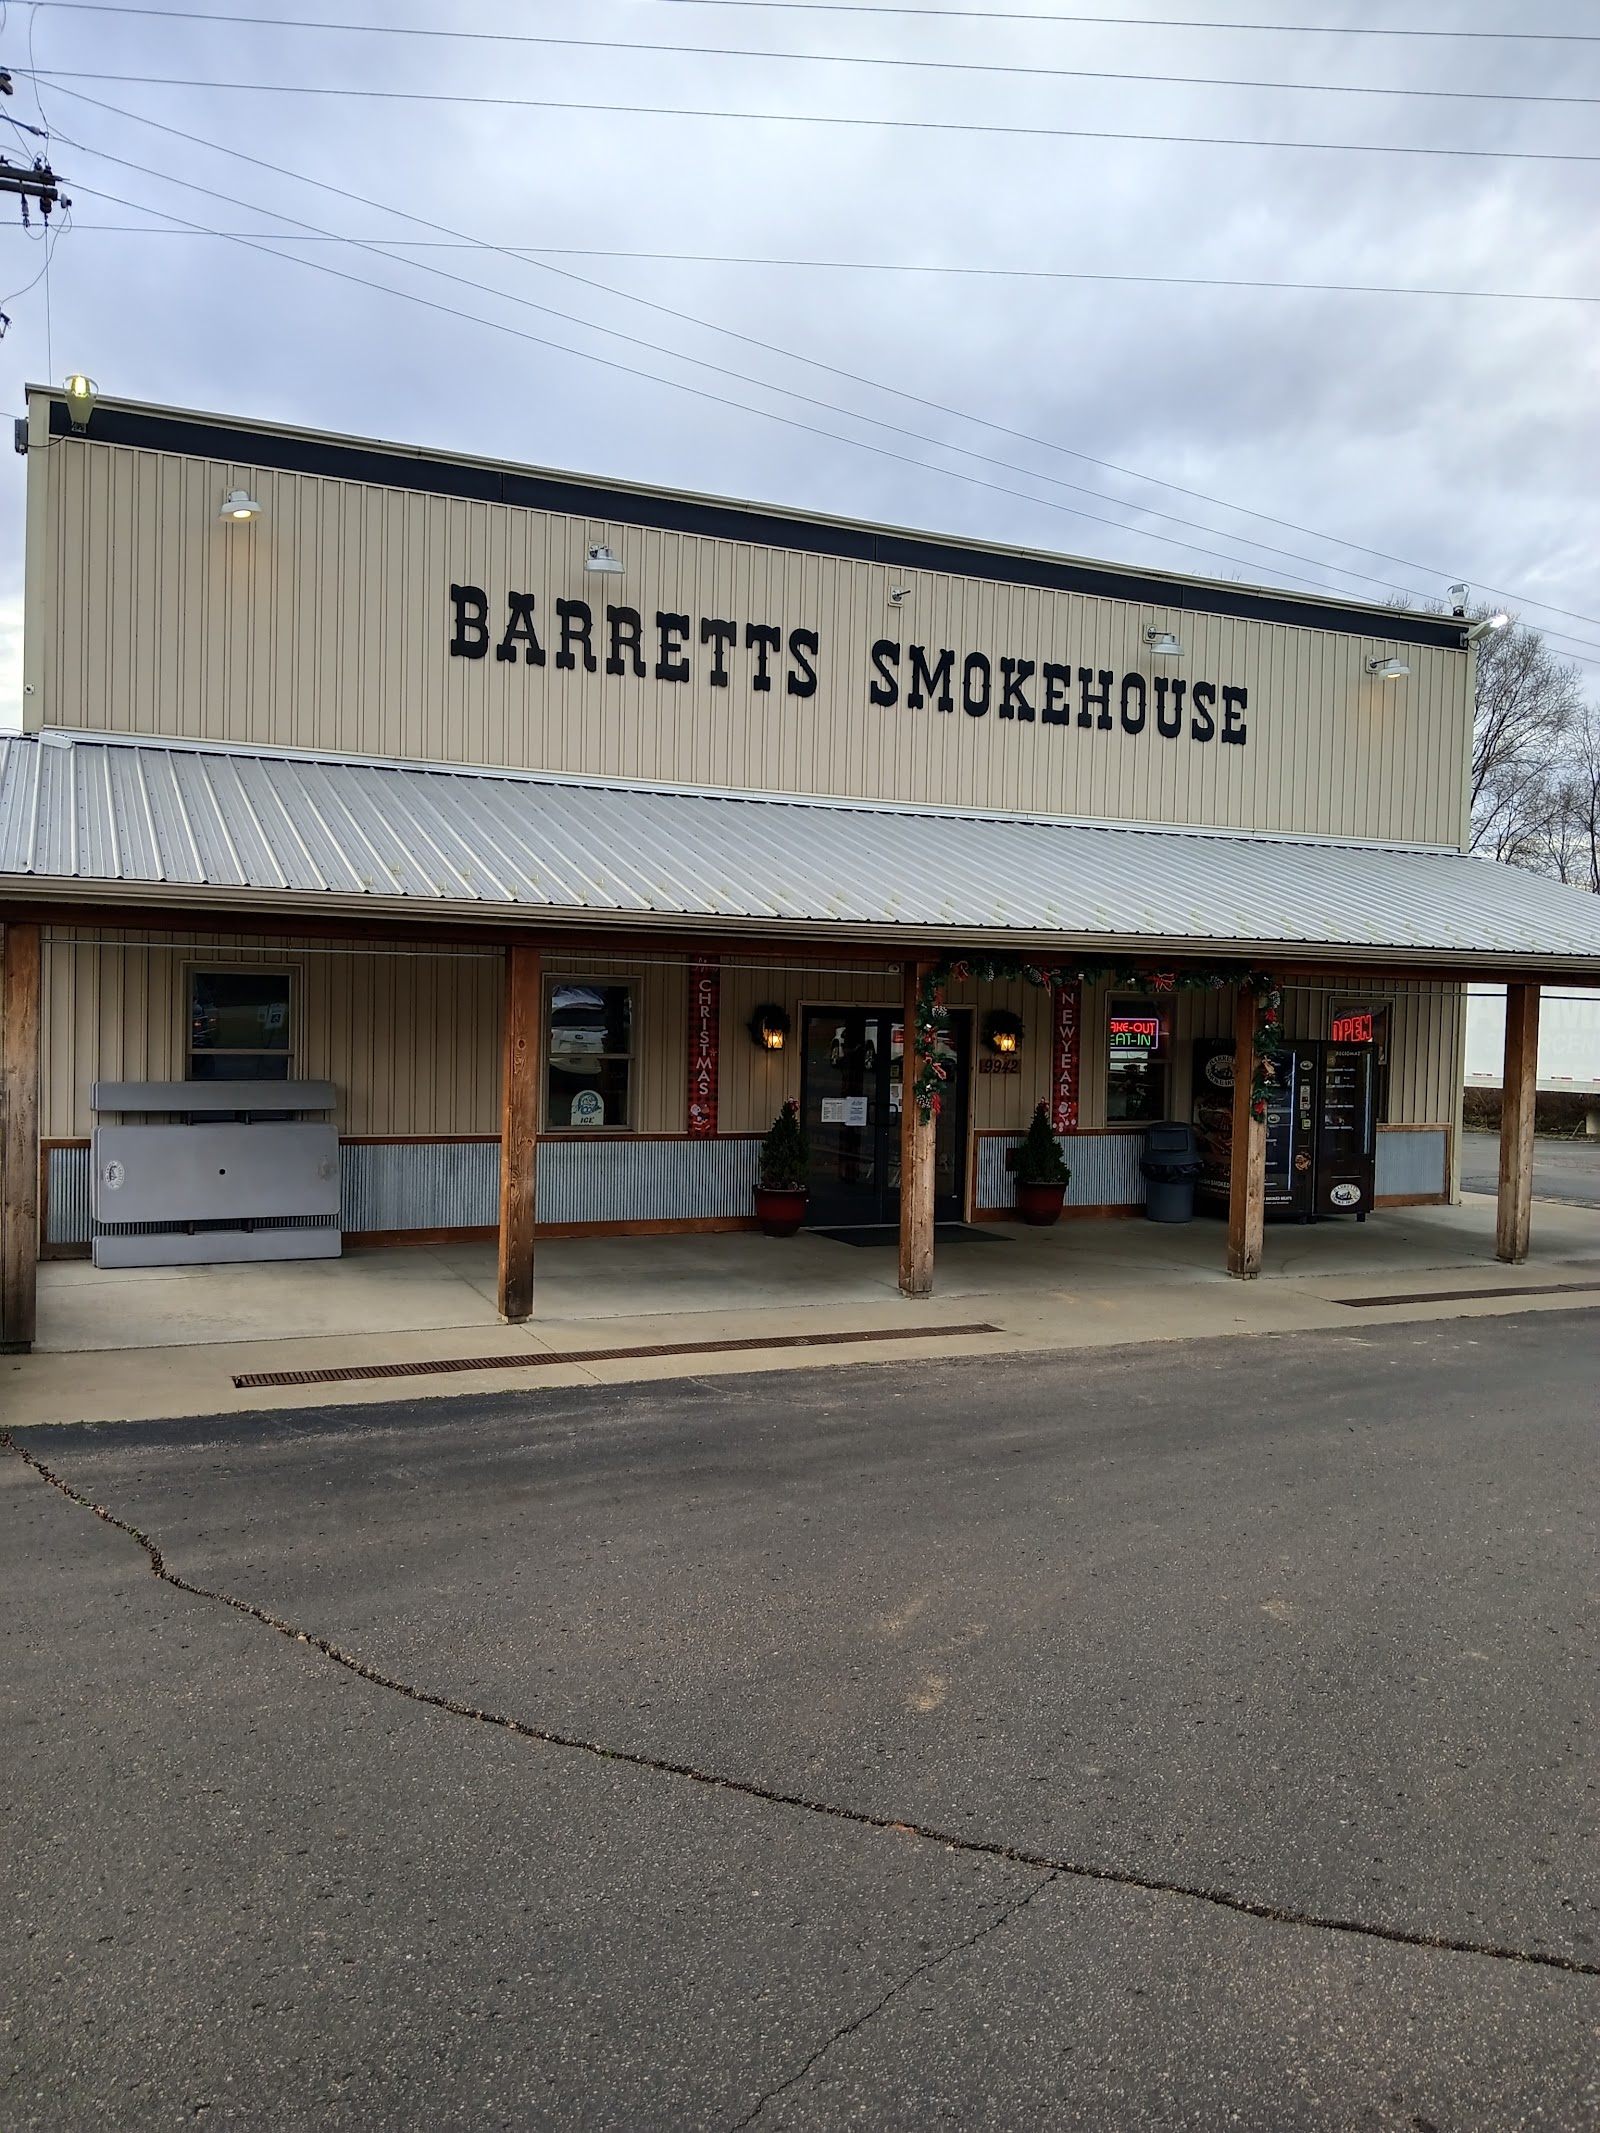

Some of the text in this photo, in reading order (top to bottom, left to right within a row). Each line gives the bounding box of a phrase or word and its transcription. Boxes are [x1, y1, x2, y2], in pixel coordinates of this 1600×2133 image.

[450, 583, 1248, 745] BARRETTS SMOKEHOUSE
[695, 979, 712, 1095] CHRISTMAS
[1110, 1021, 1156, 1036] AKE-OUT
[1332, 1014, 1372, 1042] OPEN
[984, 1059, 1019, 1073] 9942
